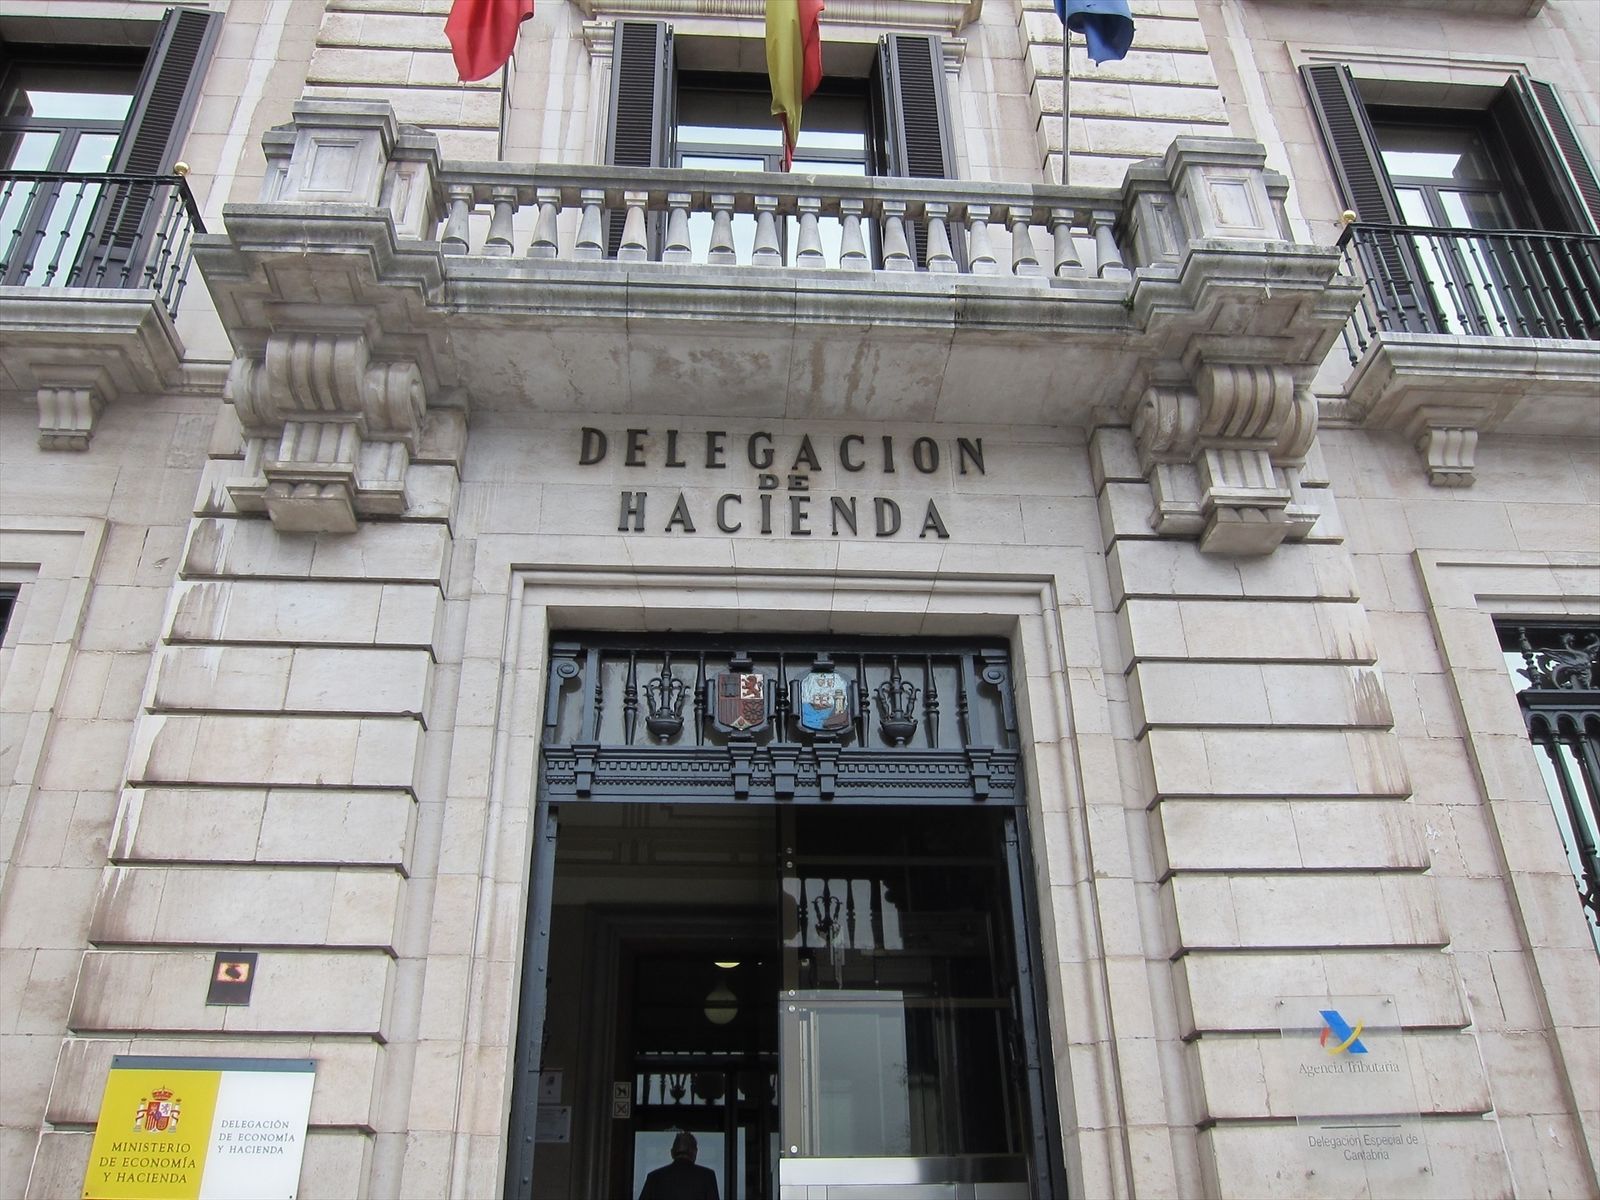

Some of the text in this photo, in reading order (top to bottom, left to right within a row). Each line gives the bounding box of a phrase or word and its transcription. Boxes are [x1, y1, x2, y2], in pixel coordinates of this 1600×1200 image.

[578, 427, 986, 475] DELEGACION
[758, 473, 809, 491] DE
[617, 491, 950, 539] HACIENDA
[1299, 1060, 1400, 1077] Agencia Tributaria
[221, 1119, 289, 1129] DELEGACIÓN
[218, 1132, 295, 1142] DE ECONOMÍA
[1308, 1133, 1419, 1149] Delegación Especial de
[111, 1142, 191, 1153] MINISTERIO
[217, 1145, 284, 1154] Y HACIENDA
[1343, 1149, 1390, 1161] Cantabria
[99, 1156, 196, 1169] DE ECONOMÍA
[103, 1172, 187, 1184] Y HACIENDA
